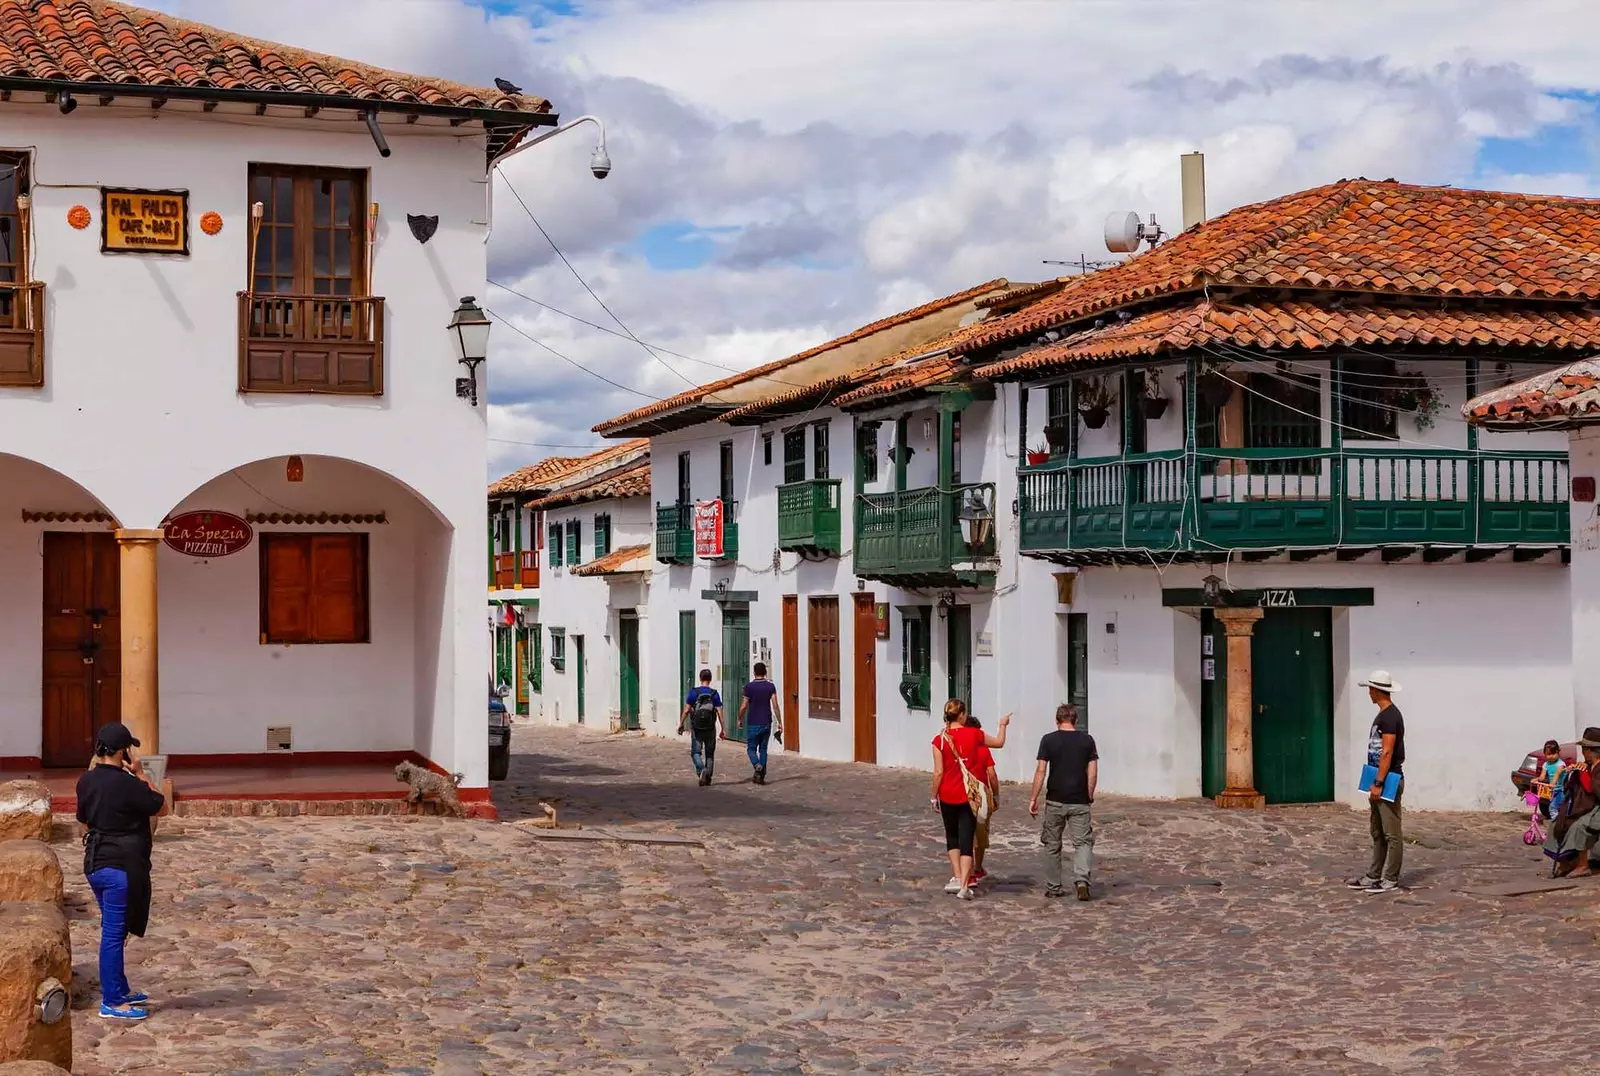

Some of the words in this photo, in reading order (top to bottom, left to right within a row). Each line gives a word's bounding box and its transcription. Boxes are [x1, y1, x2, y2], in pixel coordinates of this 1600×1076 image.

[111, 198, 136, 217] PAL
[168, 525, 192, 539] La
[194, 525, 245, 542] Spezia
[184, 541, 228, 555] PIZZERIA
